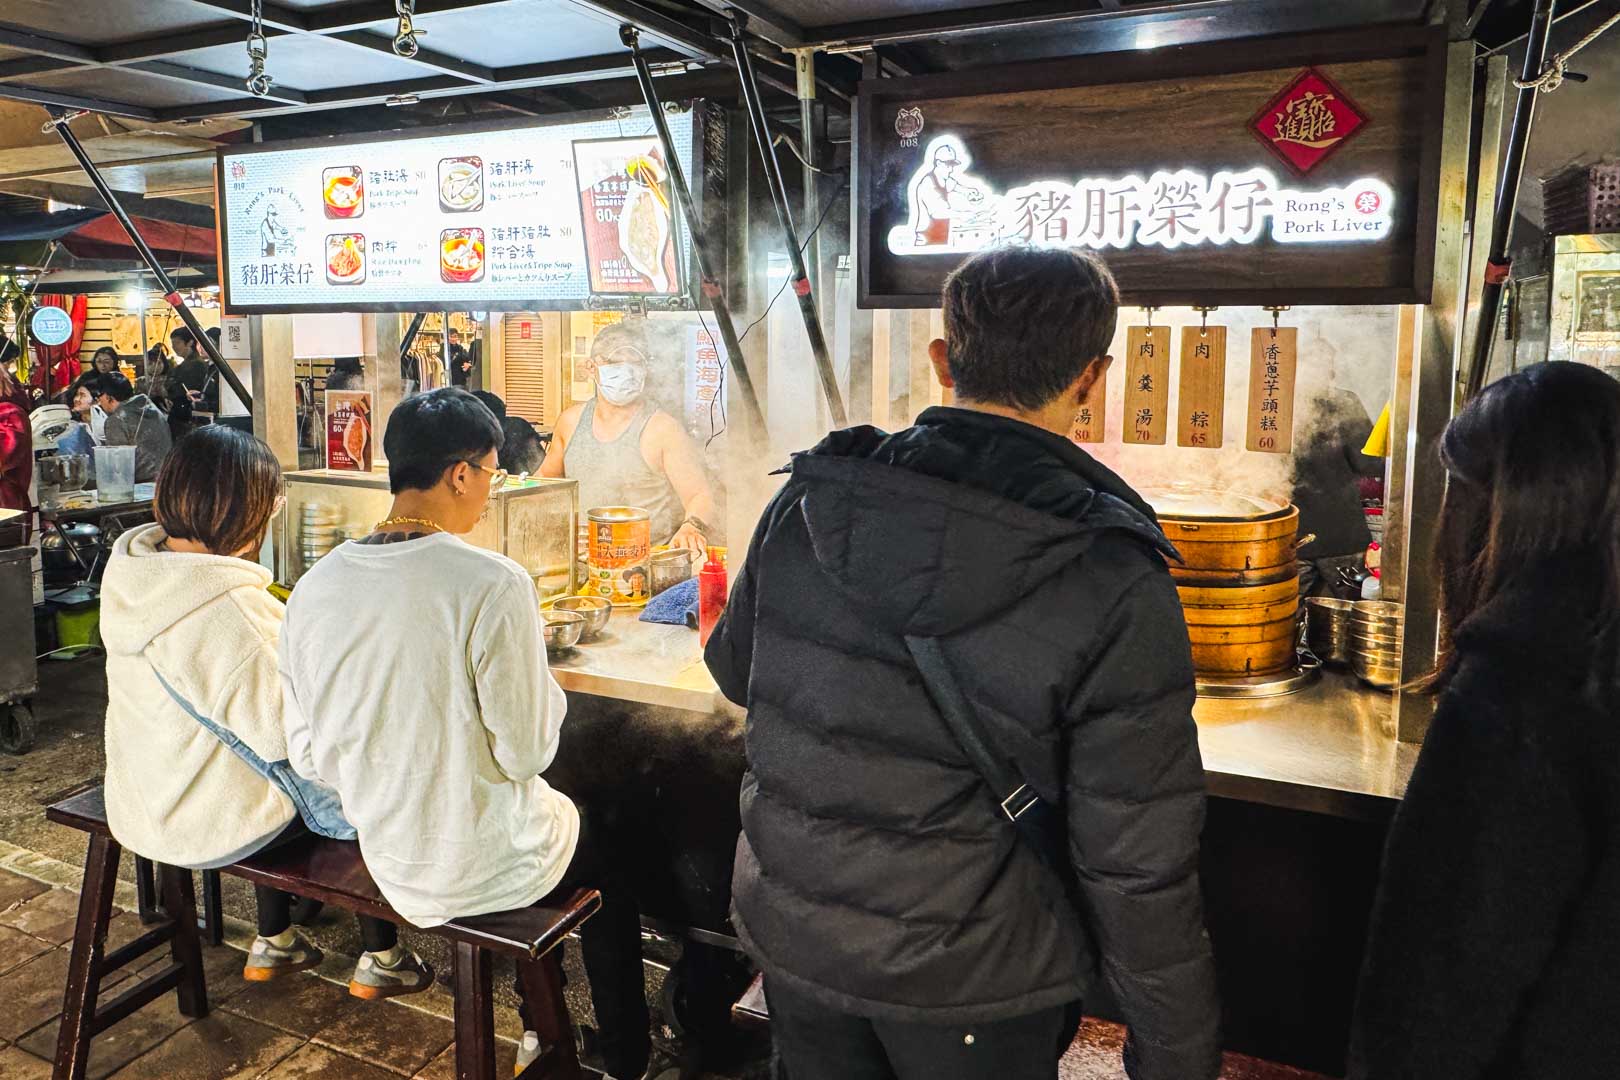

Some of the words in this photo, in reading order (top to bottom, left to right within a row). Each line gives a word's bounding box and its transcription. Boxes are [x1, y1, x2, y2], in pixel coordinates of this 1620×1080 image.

[900, 138, 918, 147] 008
[1015, 178, 1274, 242] 豬肝榮仔
[1286, 197, 1345, 214] Rong's
[1283, 220, 1325, 233] Pork
[1332, 218, 1382, 232] Liver
[241, 263, 314, 286] 豬肝榮仔
[1075, 430, 1089, 441] 80
[1136, 430, 1150, 441] 70
[1191, 433, 1206, 446] 65
[1259, 437, 1274, 448] 60
